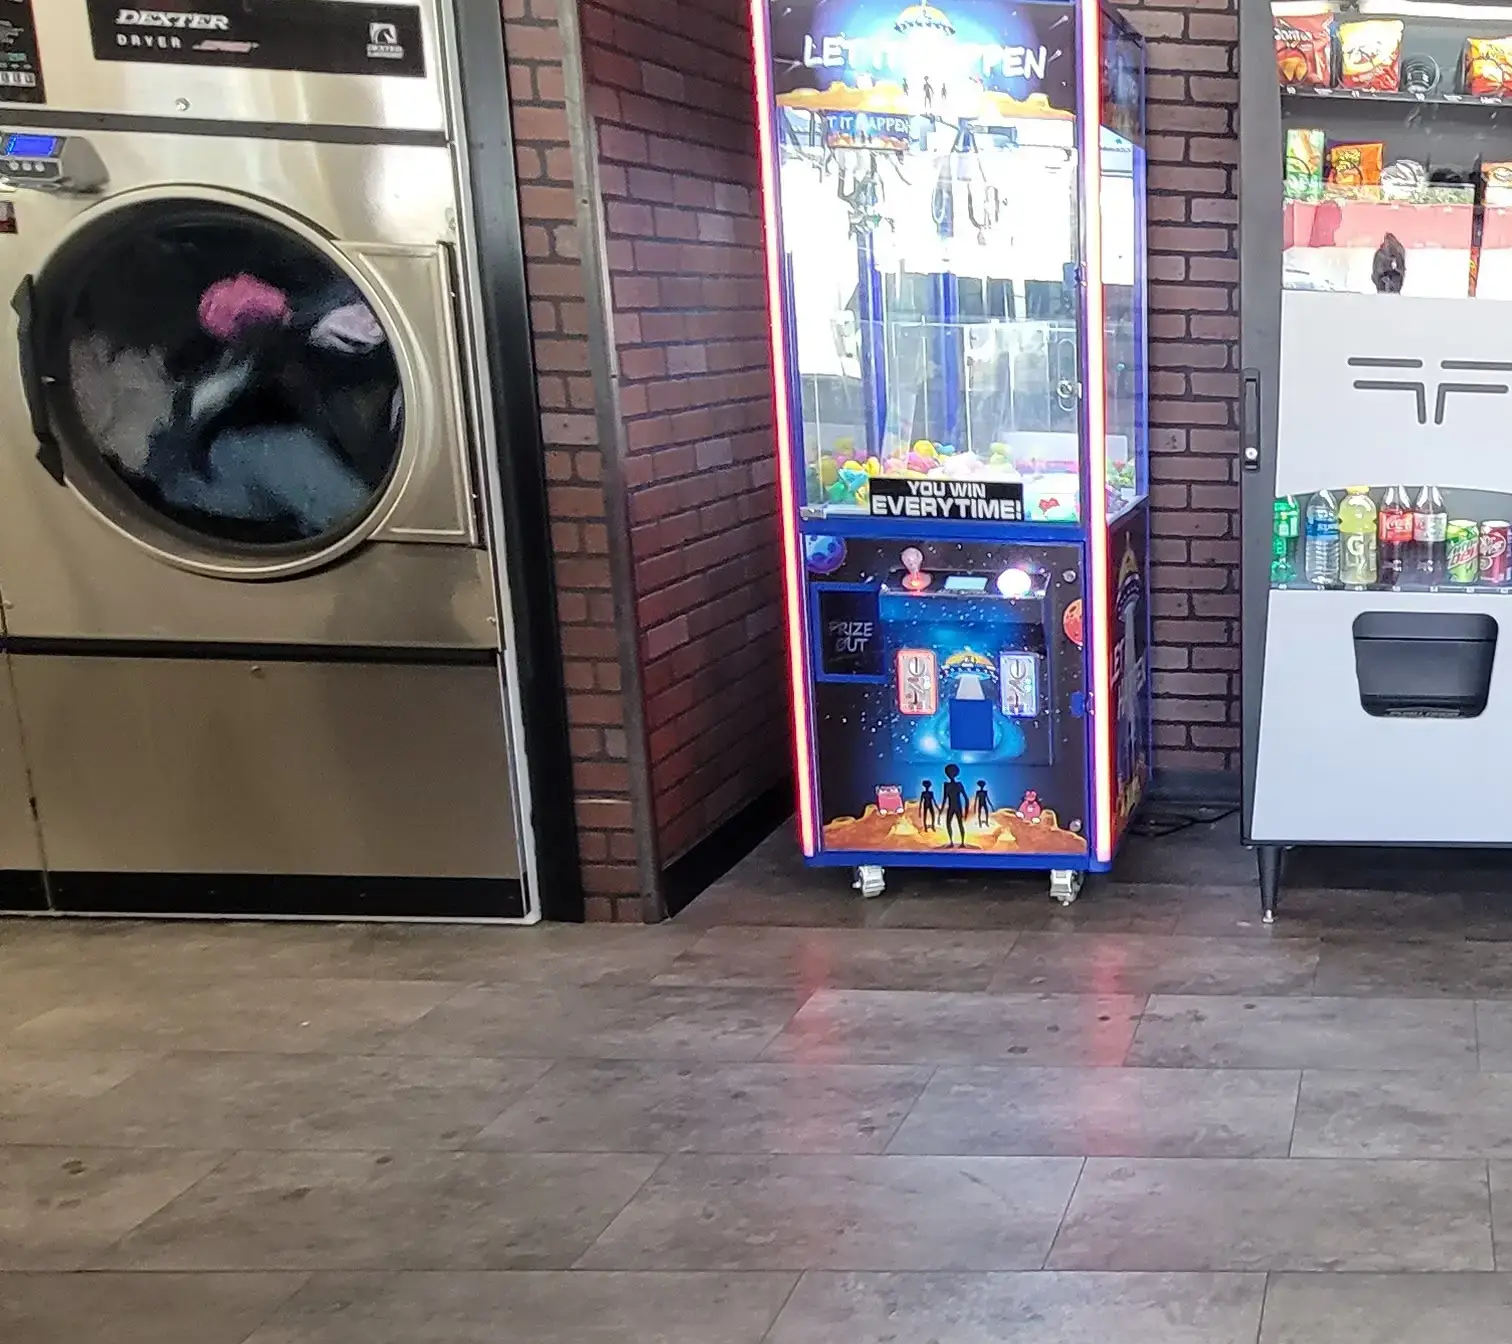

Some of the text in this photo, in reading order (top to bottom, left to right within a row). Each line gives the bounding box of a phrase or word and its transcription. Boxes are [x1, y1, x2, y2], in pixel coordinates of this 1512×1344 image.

[115, 8, 230, 31] DEXTER
[115, 32, 183, 49] DRYER
[906, 480, 986, 498] YOU WIN
[871, 494, 1022, 521] EVERYTIME!
[828, 621, 873, 637] PRIZE
[835, 636, 869, 653] OUT
